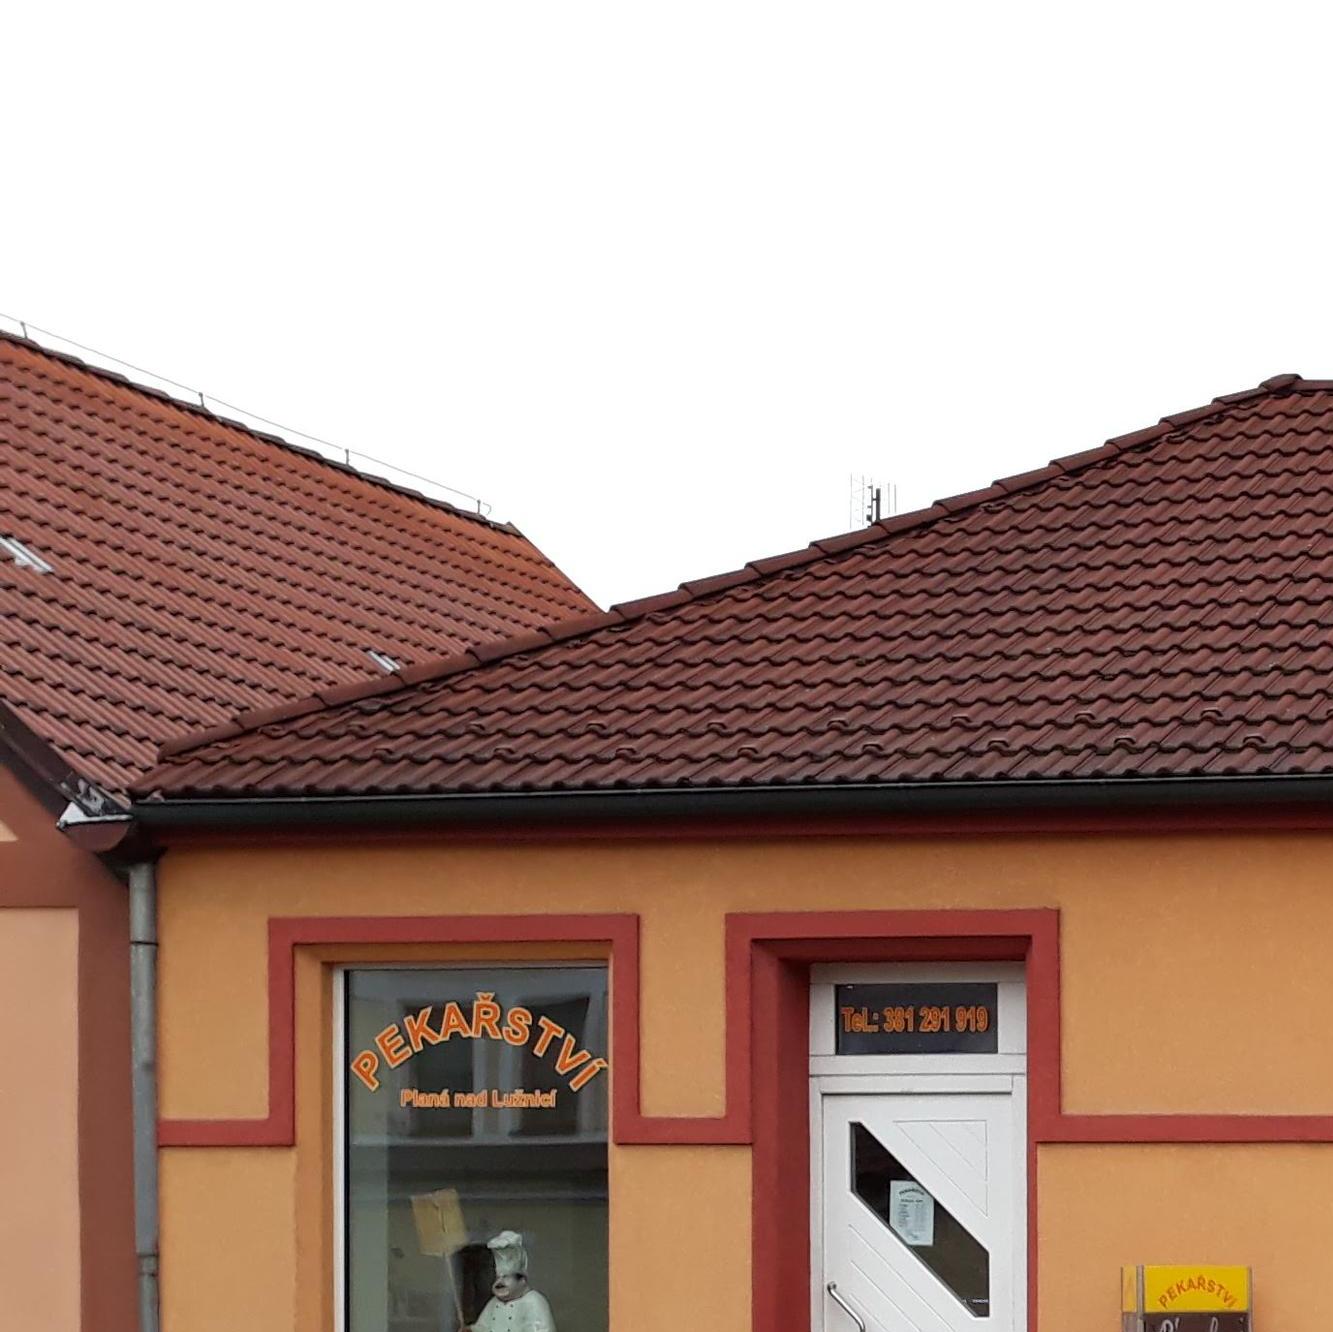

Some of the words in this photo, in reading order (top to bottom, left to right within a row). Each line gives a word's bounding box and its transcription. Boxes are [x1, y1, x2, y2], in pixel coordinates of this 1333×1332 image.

[883, 1006, 914, 1032] 381
[919, 1006, 950, 1032] 291
[955, 1006, 988, 1032] 919
[351, 992, 609, 1092] PEKAŘSTVÍ
[400, 1088, 451, 1108] Planá
[454, 1089, 488, 1108] nad
[491, 1088, 558, 1108] Lužnicí
